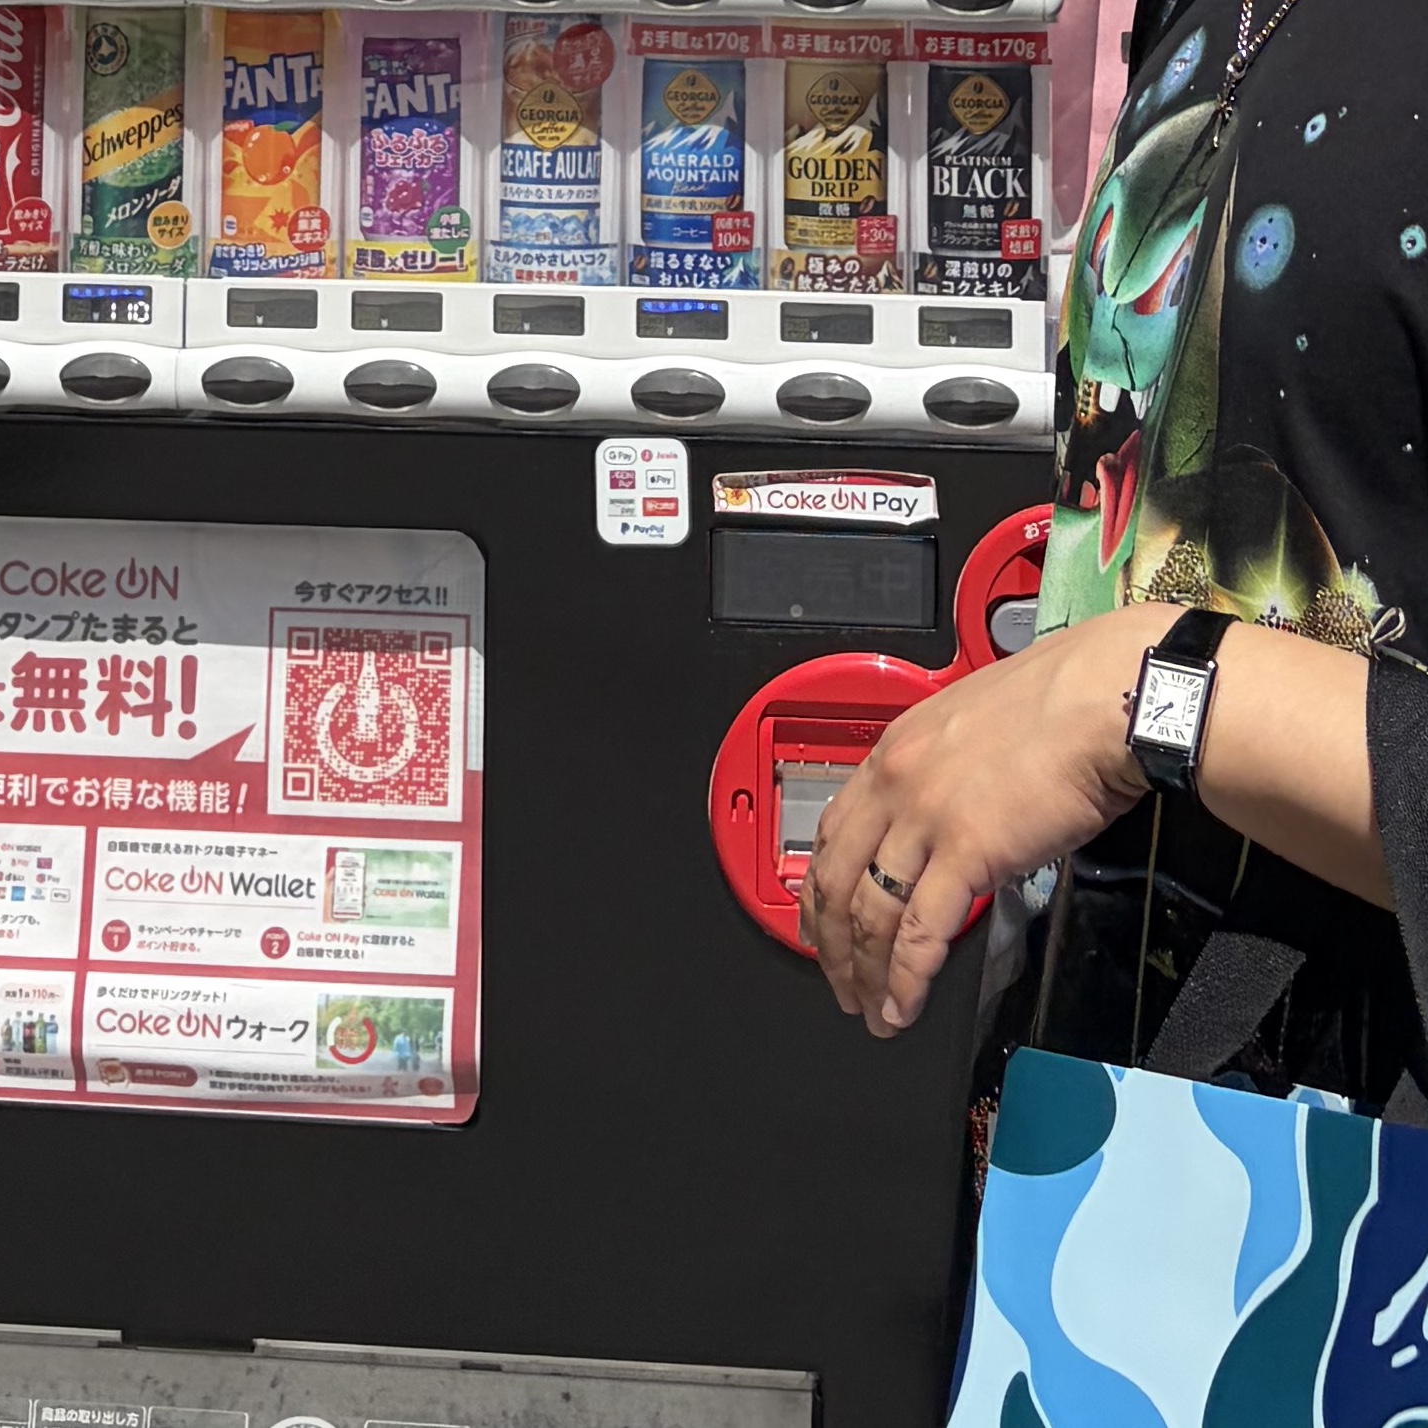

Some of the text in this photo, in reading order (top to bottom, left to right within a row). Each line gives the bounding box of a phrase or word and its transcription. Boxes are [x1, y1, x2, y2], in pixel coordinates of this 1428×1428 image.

[520, 108, 579, 122] GEORGIA
[83, 103, 184, 167] Schweppes
[371, 128, 449, 154] ふるふる
[375, 152, 445, 168] シェイカー
[651, 152, 735, 168] EMERALD
[787, 156, 883, 181] GOLDEN
[944, 154, 1013, 167] PLATINUM
[647, 168, 740, 183] MOUNTAIN
[932, 166, 1027, 198] BLACK
[811, 181, 860, 198] DRIP
[105, 176, 181, 229] メロンソーダ
[19, 221, 44, 231] サイズ
[104, 258, 186, 274] メロンソーダ
[494, 251, 607, 268] ミルクのやさしいコク
[945, 260, 1013, 278] 深煎りの
[658, 271, 721, 287] おいしさ
[797, 276, 881, 293] 飲みごたえ
[941, 279, 1021, 296] コクとキレ
[766, 486, 919, 518] Coke ON Pay
[0, 557, 180, 601] Coke ON
[294, 580, 448, 607] 今すぐアクセス!!
[104, 864, 317, 900] Coke ON Wallet
[111, 934, 119, 948] 1
[297, 931, 322, 942] Coke
[324, 932, 341, 943] ON
[342, 933, 360, 945] Pay
[271, 941, 279, 955] 2
[96, 986, 227, 1003] 歩くだけでドリンクゲット!
[95, 1007, 310, 1043] Coke ON ウォーク
[41, 1406, 140, 1427] 商品の取り出し方
